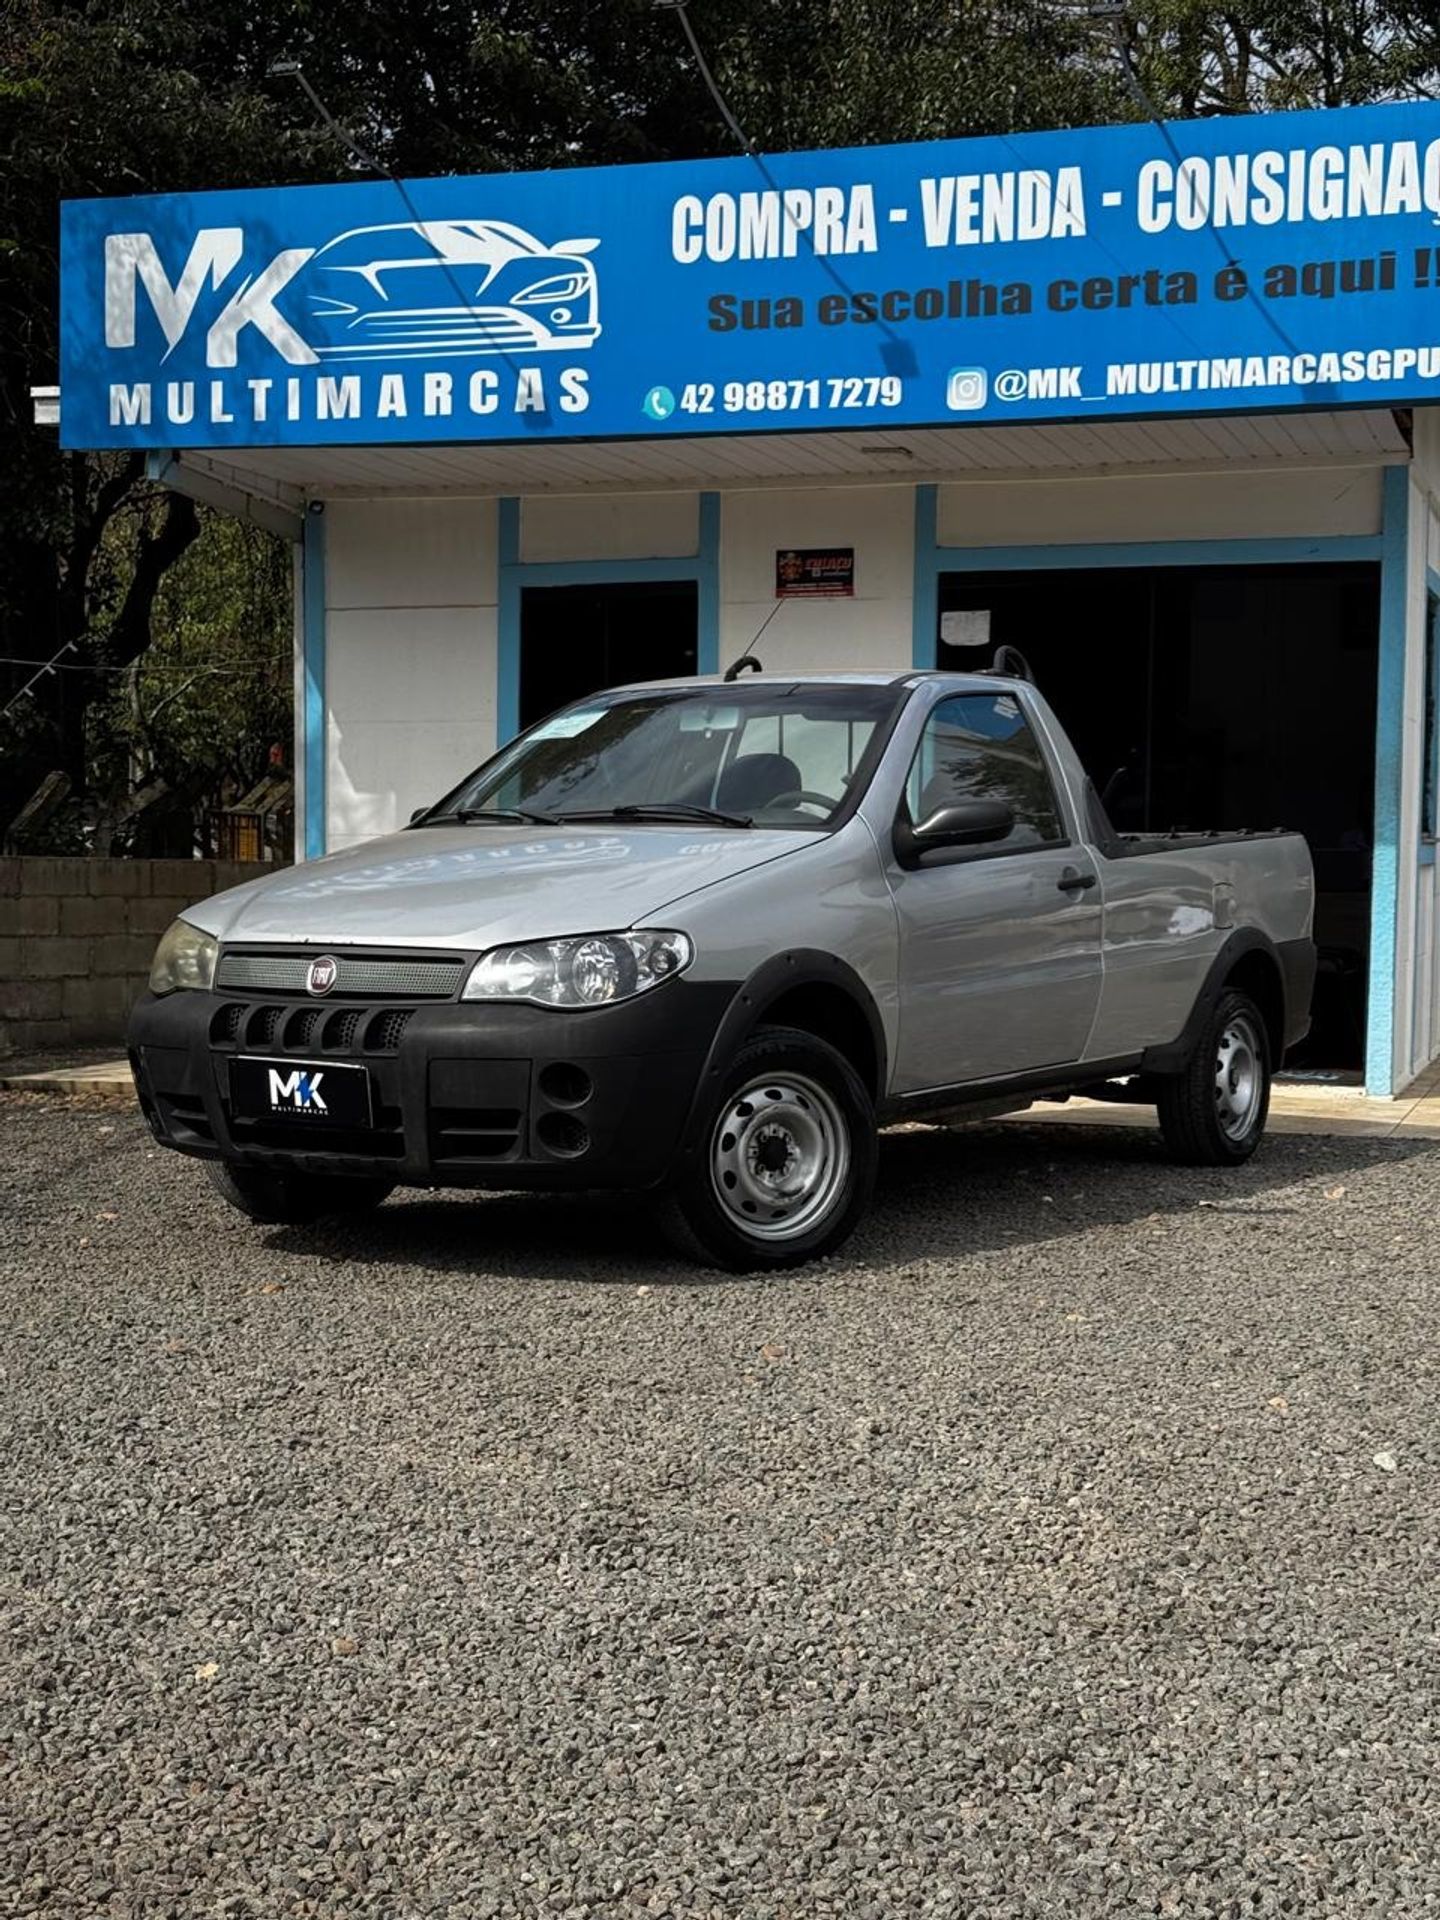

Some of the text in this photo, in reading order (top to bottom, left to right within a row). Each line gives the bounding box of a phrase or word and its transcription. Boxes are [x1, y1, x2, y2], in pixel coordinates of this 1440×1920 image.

[672, 184, 878, 264] COMPRA
[889, 208, 908, 222] -
[920, 166, 1087, 248] VENDA
[1102, 191, 1122, 207] -
[105, 227, 320, 368] MK
[708, 294, 802, 332] Sua
[818, 279, 1032, 327] escolha
[1047, 268, 1198, 312] certa
[1214, 259, 1248, 301] é
[1263, 250, 1396, 299] aqui
[109, 368, 590, 426] MULTIMARCAS
[681, 376, 902, 414] 42 98871 7279
[268, 1069, 327, 1109] MK
[271, 1105, 329, 1116] MULTIMARCAS
